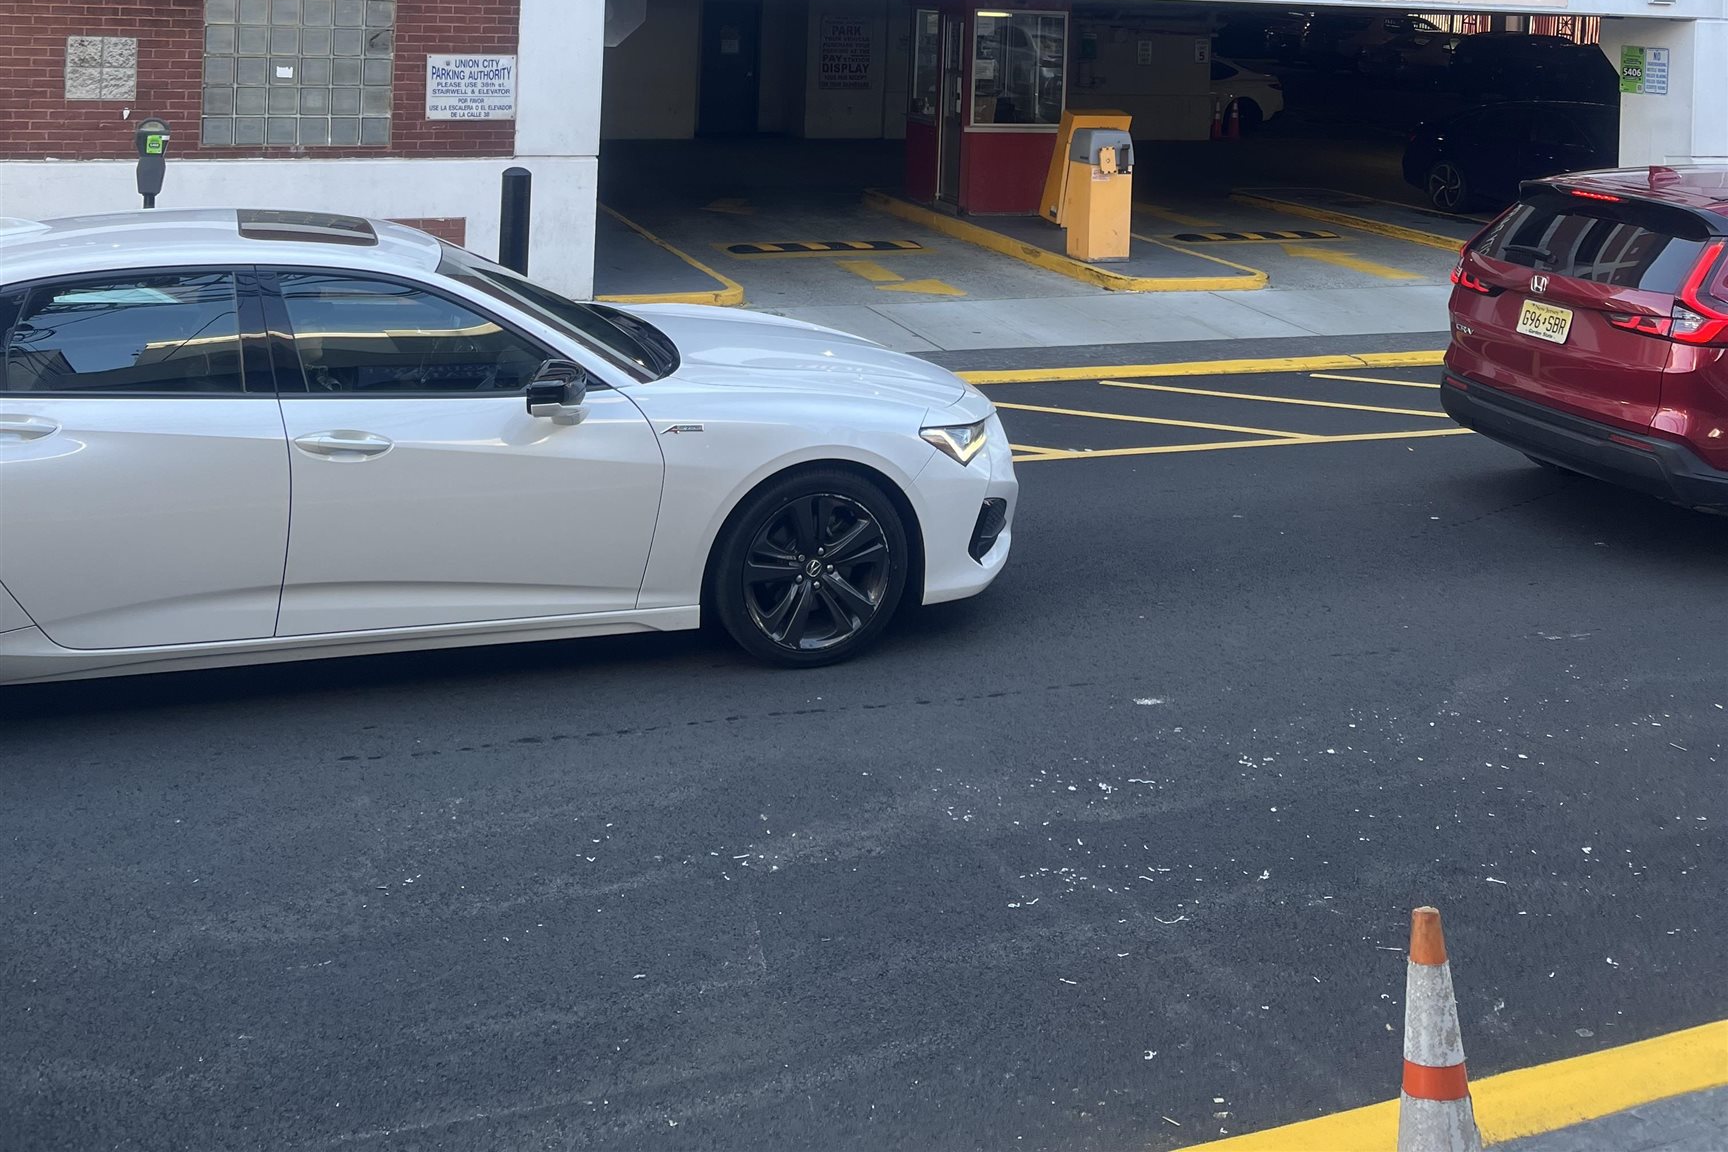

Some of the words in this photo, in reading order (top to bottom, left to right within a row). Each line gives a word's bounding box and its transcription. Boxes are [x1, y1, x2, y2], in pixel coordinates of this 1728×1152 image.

[832, 25, 861, 35] PARK
[822, 54, 841, 62] PAY
[1199, 51, 1205, 61] 5
[455, 59, 479, 68] UNION
[482, 59, 500, 68] CITY
[822, 63, 870, 73] DISPLAY
[431, 66, 465, 80] PARKING
[468, 66, 511, 80] AUTHORITY
[1623, 68, 1642, 77] 5406
[1522, 309, 1541, 328] G96
[1546, 316, 1567, 335] SBR
